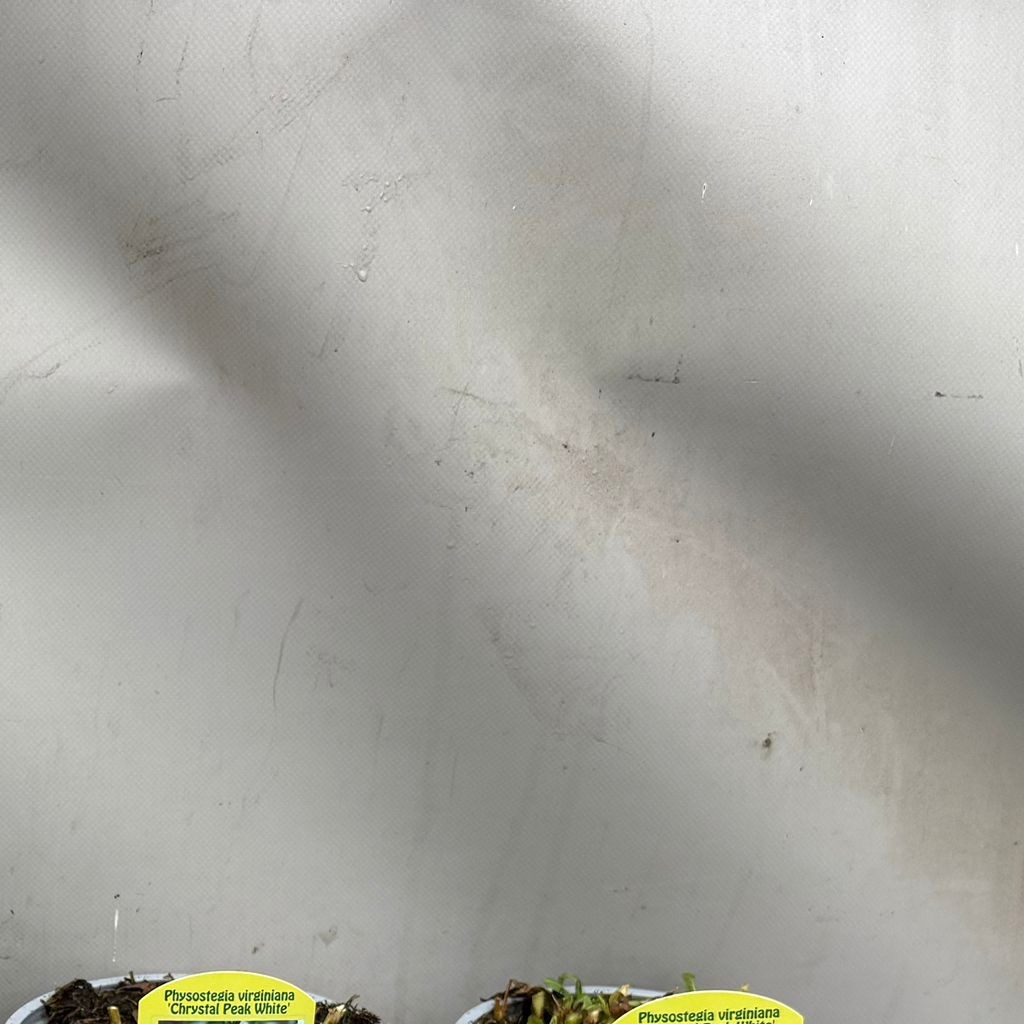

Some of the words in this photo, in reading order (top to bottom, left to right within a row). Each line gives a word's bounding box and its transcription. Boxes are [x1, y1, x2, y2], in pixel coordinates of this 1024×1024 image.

[164, 989, 234, 1002] Physostegia
[238, 989, 295, 1001] virginiana
[168, 1003, 219, 1015] 'Chrystal
[223, 1003, 251, 1015] Peak
[254, 1002, 290, 1014] White'
[638, 1009, 714, 1024] Physostegia
[718, 1007, 780, 1020] virginiana
